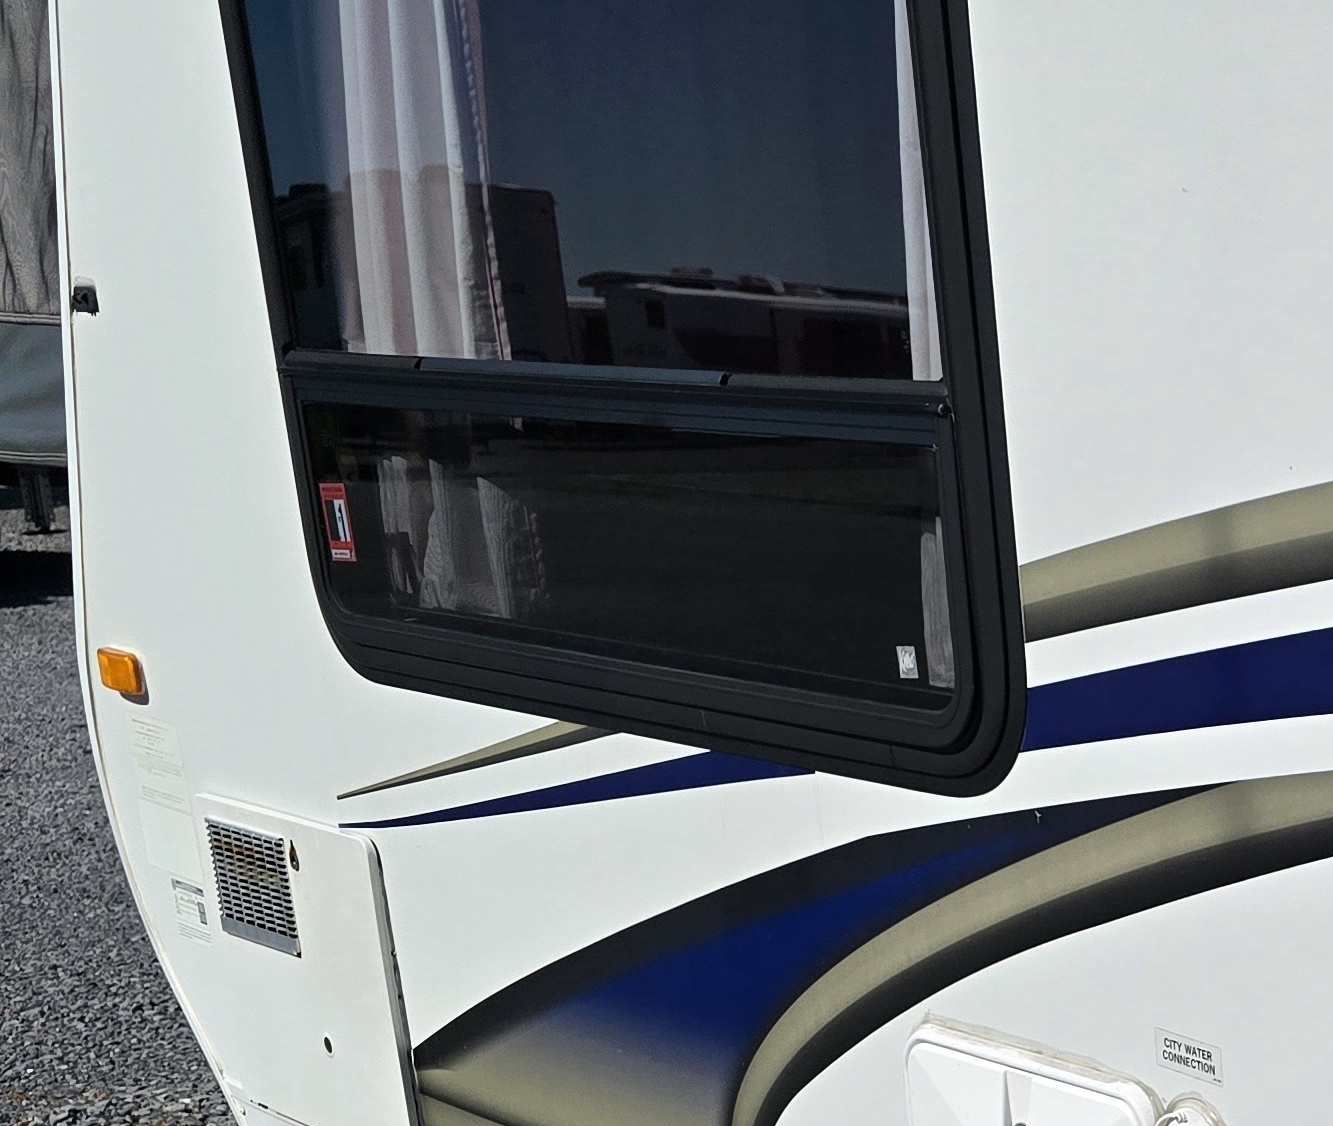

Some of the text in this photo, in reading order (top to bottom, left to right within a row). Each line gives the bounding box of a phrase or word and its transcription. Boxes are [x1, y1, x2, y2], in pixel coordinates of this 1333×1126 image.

[1162, 1049, 1216, 1076] CONNECTION
[1163, 1037, 1213, 1062] CITY WATER
